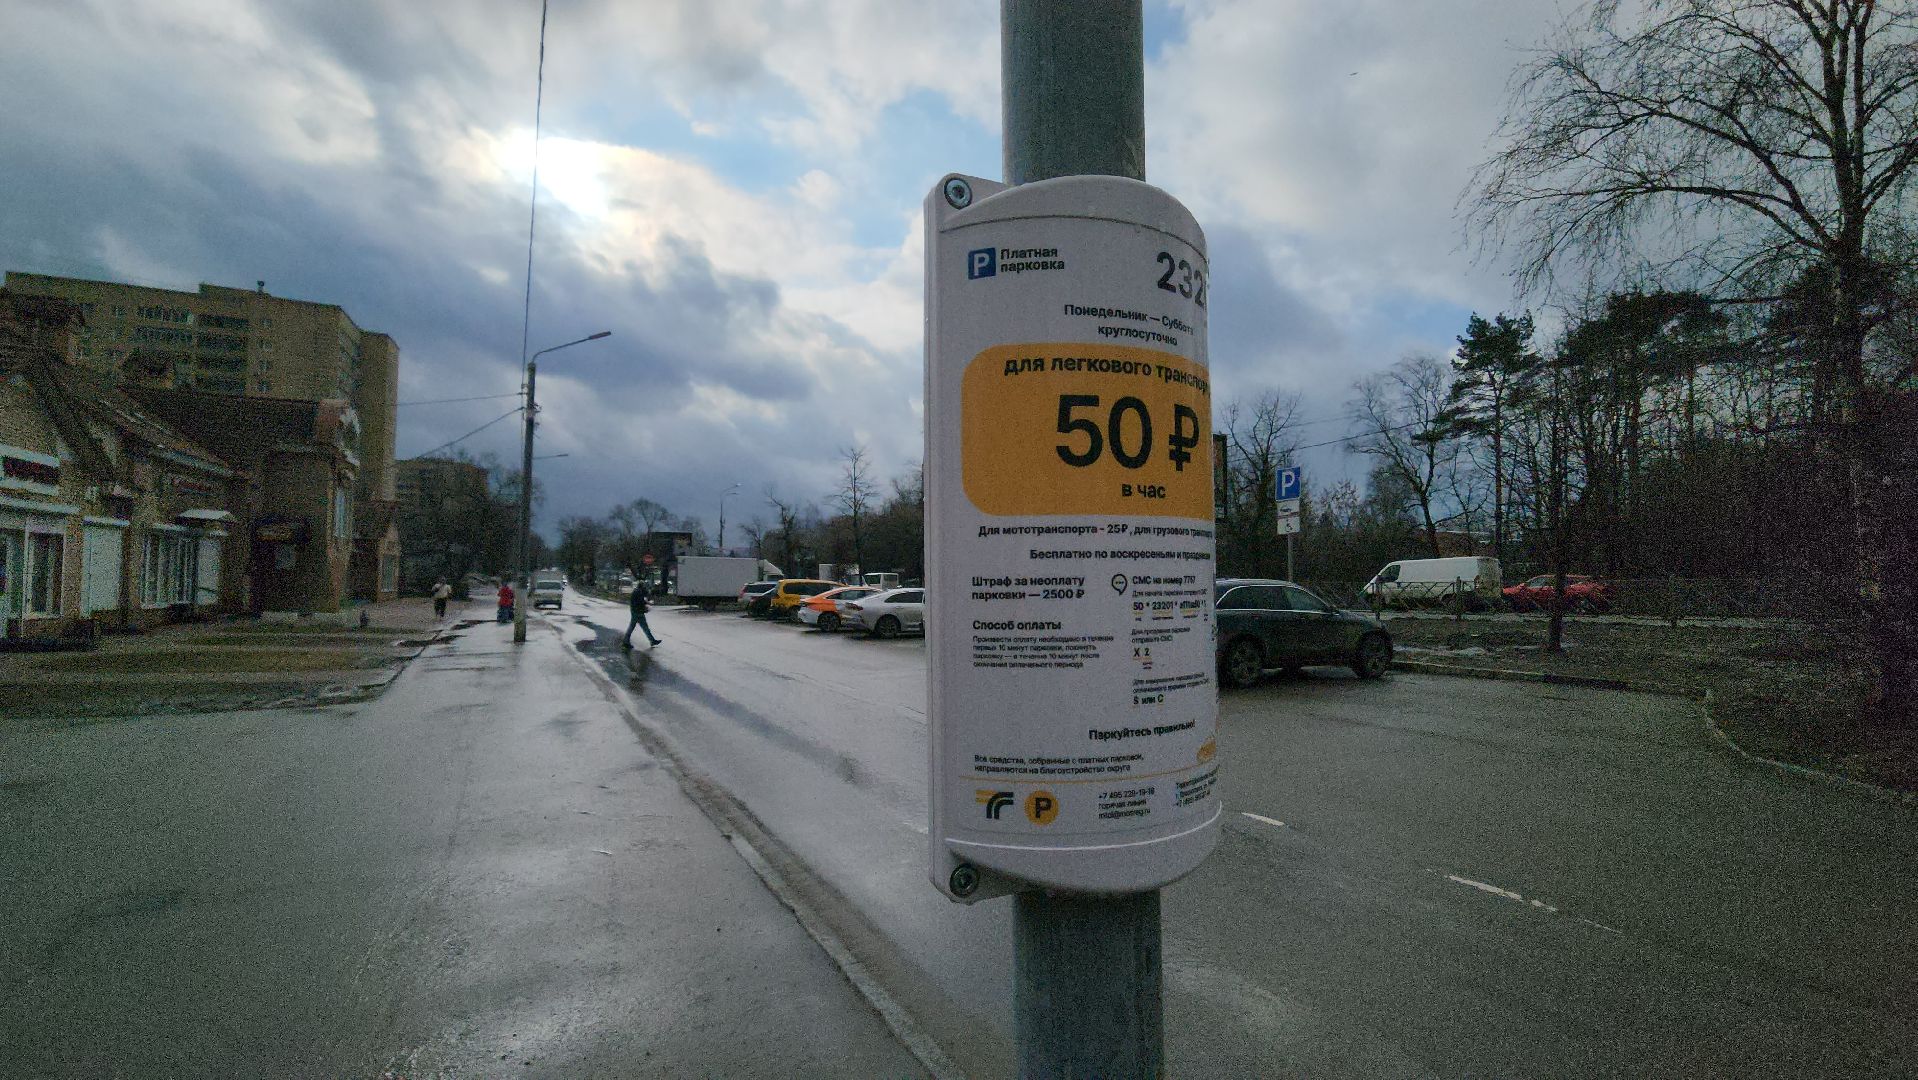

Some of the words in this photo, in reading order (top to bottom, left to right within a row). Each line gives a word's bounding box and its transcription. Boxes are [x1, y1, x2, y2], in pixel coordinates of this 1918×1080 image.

[1000, 248, 1058, 260] Платная
[1000, 260, 1065, 274] парковка
[1064, 304, 1148, 322] Понедельник
[1098, 325, 1178, 346] круглосуточно
[1004, 357, 1045, 376] для
[1051, 356, 1152, 377] легкового
[1155, 364, 1209, 395] транспор
[1056, 394, 1152, 470] 50
[1281, 471, 1295, 497] P
[1122, 484, 1133, 497] в
[1136, 484, 1166, 498] час
[978, 525, 1000, 537] Для
[1002, 524, 1098, 537] мототранспорта
[1134, 526, 1151, 536] для
[1153, 526, 1190, 538] грузового
[1030, 549, 1093, 560] Бесплатно
[1095, 550, 1108, 559] по
[1110, 550, 1176, 561] воскресеньям
[1177, 551, 1182, 559] и
[972, 576, 1012, 588] Штраф
[1015, 577, 1028, 586] за
[1030, 576, 1085, 587] неоплату
[1132, 575, 1152, 585] СМС
[1153, 577, 1162, 585] на
[1162, 577, 1183, 586] номер
[972, 591, 1026, 602] парковки
[1043, 589, 1073, 599] 2500
[1133, 602, 1144, 611] 50
[973, 620, 1015, 630] Способ
[1017, 620, 1062, 630] оплаты
[973, 635, 1012, 643] Произвести
[1013, 636, 1037, 644] оплату
[1141, 696, 1156, 705] или
[1089, 727, 1152, 742] Паркуйтесь
[974, 754, 987, 763] Все
[1028, 756, 1070, 766] собранные
[1078, 756, 1109, 765] платных
[974, 765, 1028, 774] направляются
[1040, 765, 1105, 775] благоустройство
[1107, 764, 1131, 774] округа
